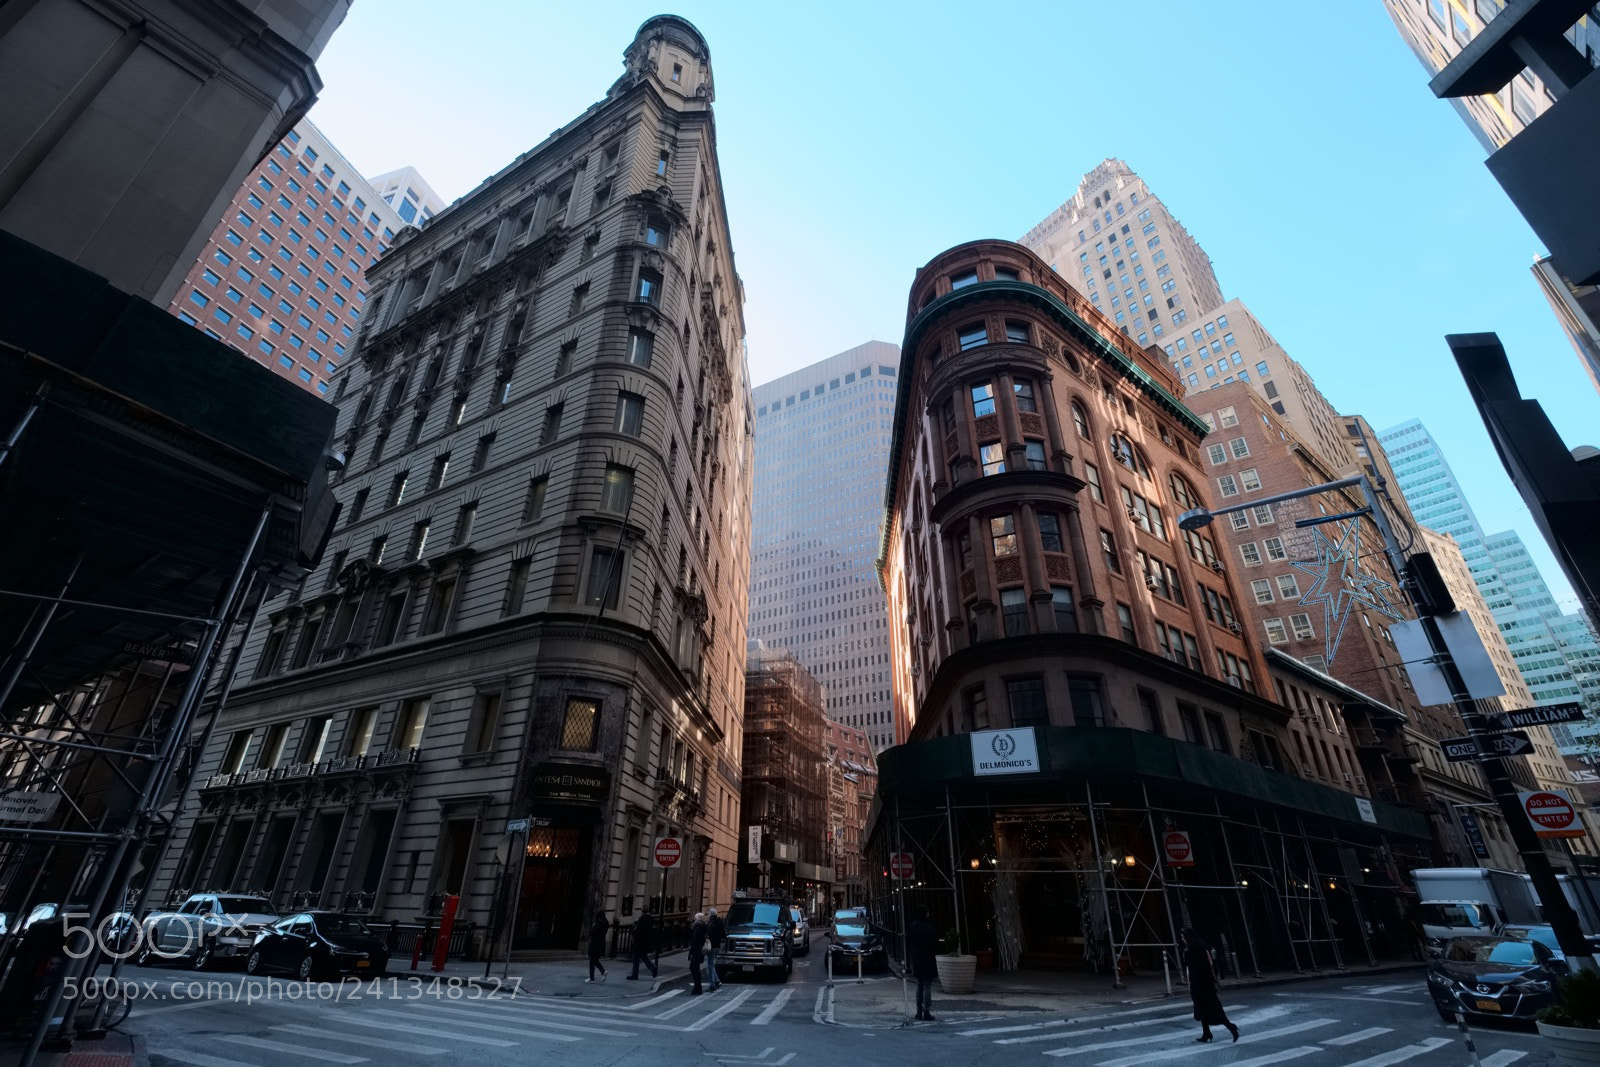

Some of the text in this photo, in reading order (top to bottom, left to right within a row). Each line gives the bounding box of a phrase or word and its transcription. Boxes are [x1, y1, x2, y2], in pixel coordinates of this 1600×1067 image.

[124, 642, 166, 658] BEAVER
[1512, 709, 1570, 724] WILLIAM
[1450, 744, 1476, 755] ONE
[980, 760, 1032, 770] DELMONICO'S
[1530, 798, 1561, 807] DO NOT
[28, 806, 48, 814] Deli
[1538, 815, 1569, 824] ENTER
